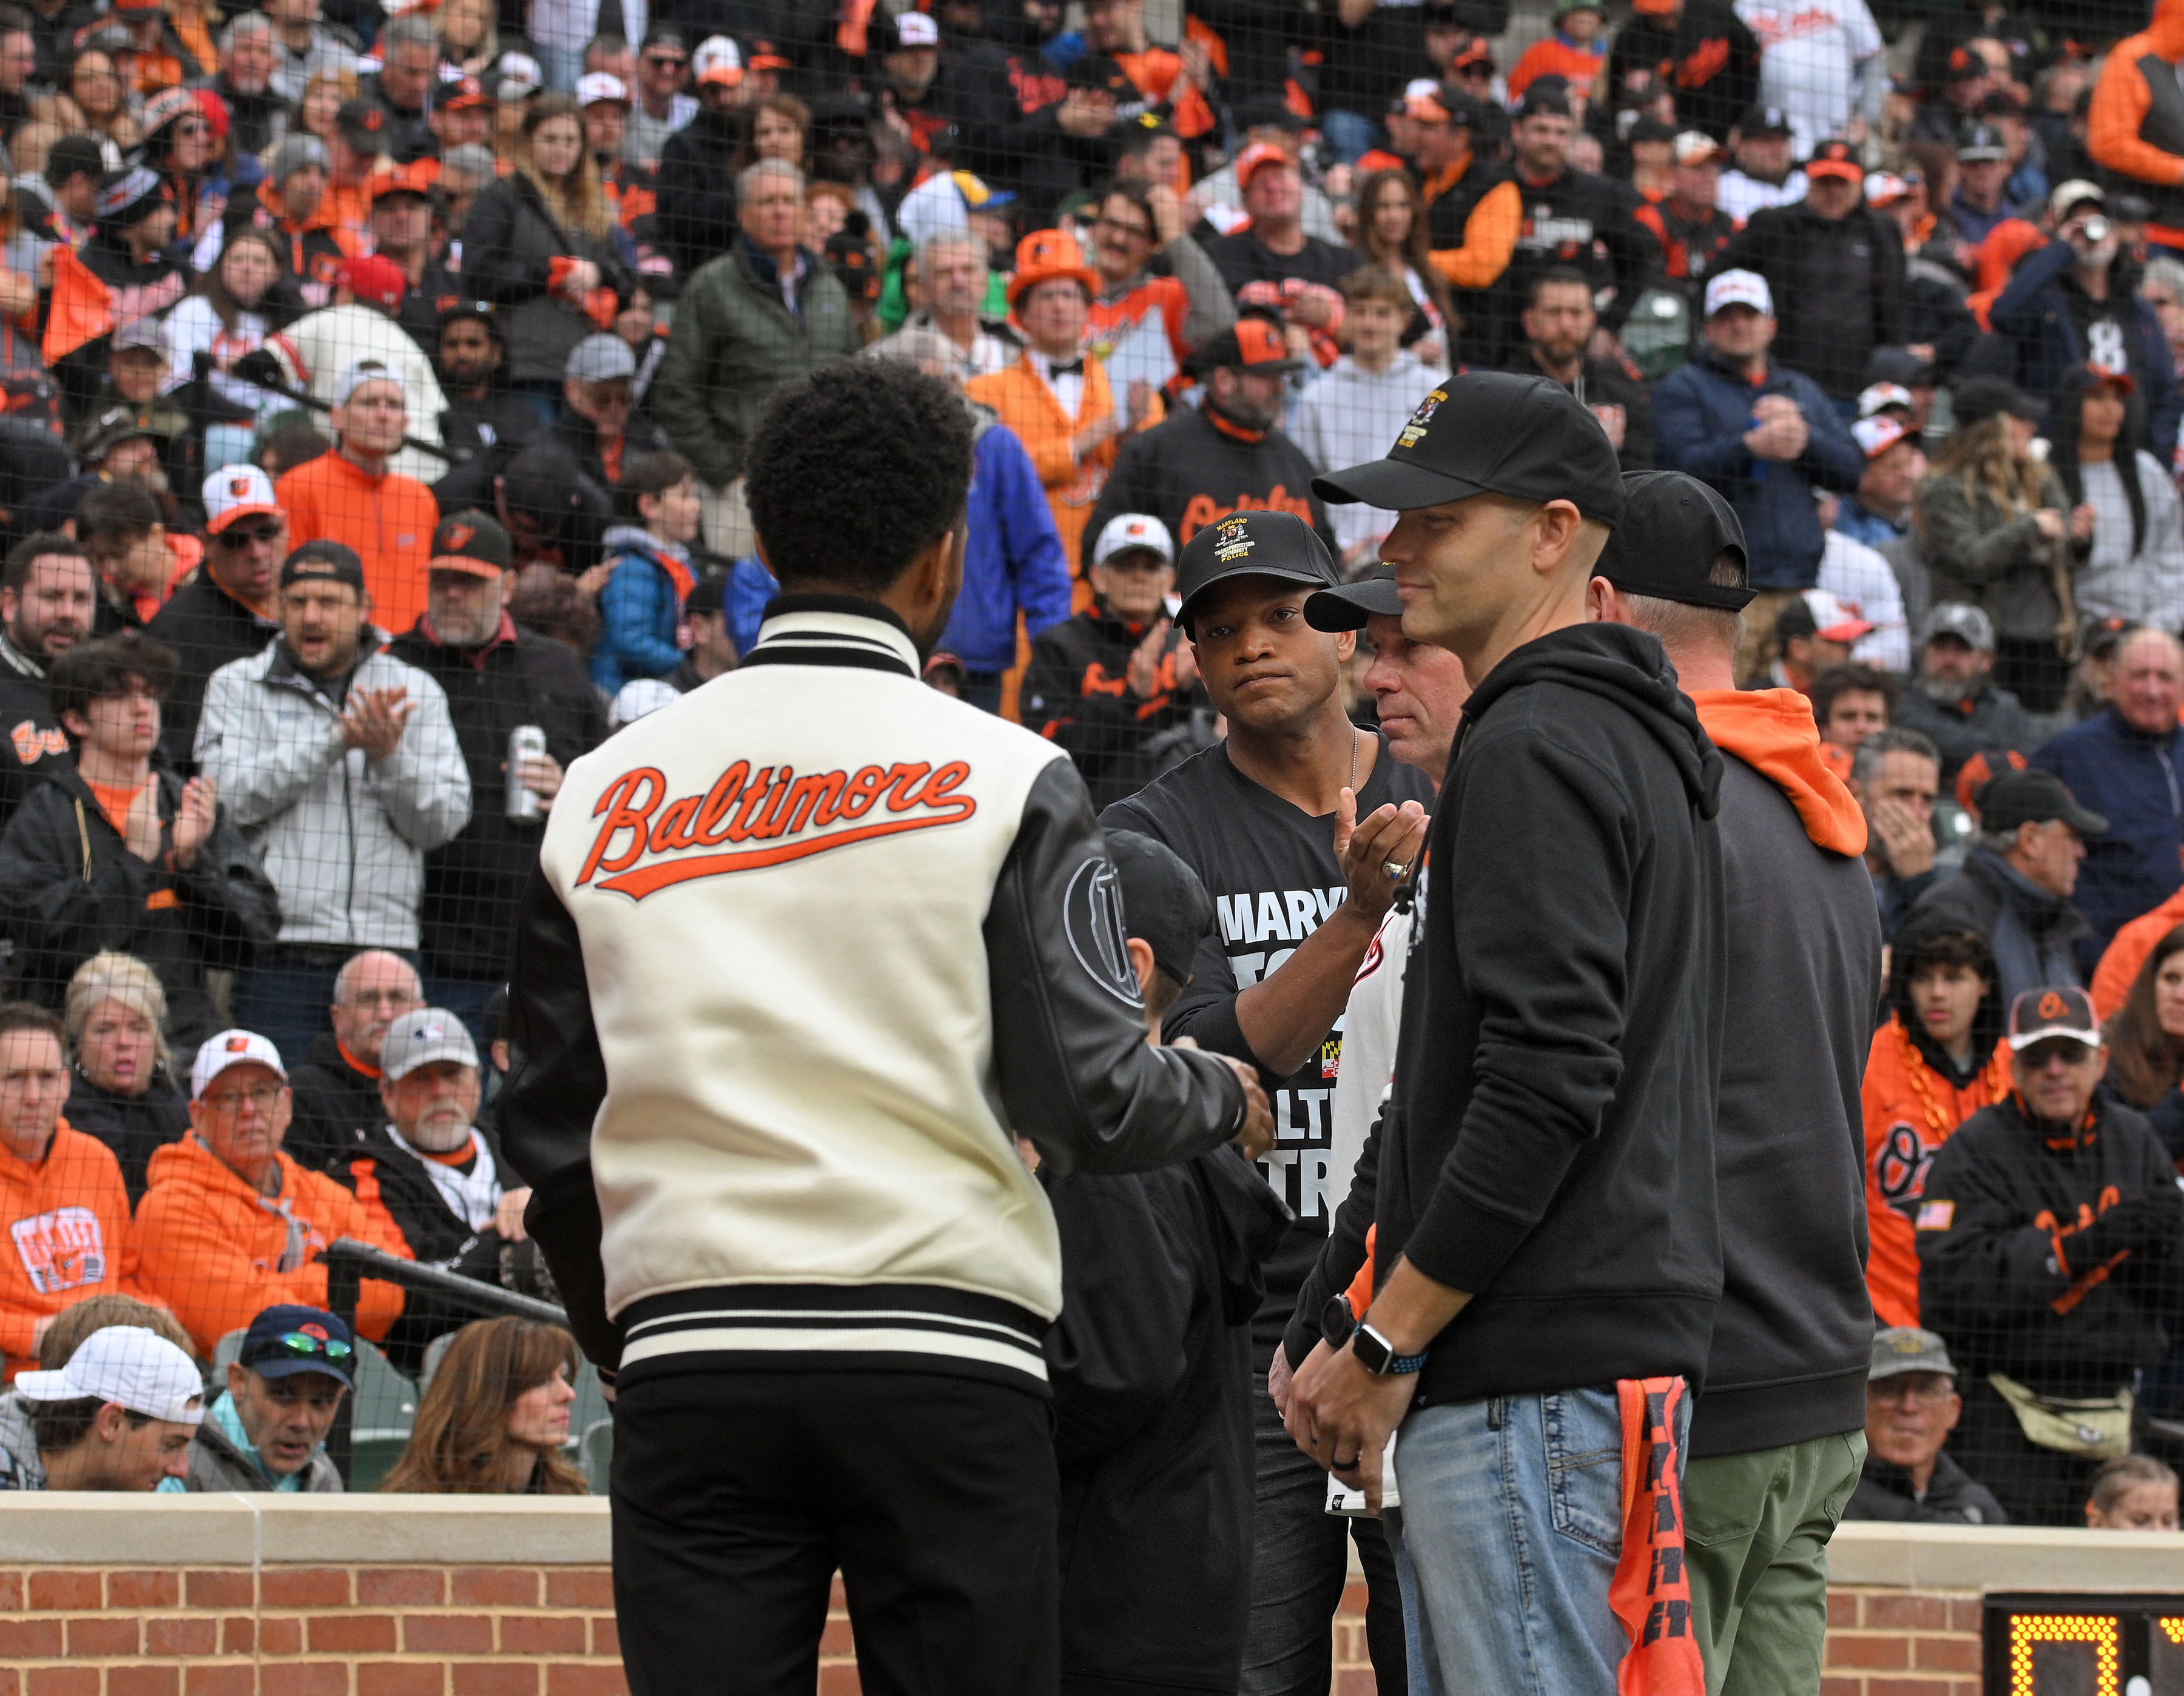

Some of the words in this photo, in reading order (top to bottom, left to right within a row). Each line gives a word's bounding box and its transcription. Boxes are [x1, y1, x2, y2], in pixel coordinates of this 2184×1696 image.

[1216, 518, 1247, 531] MARYLAND
[1214, 541, 1255, 556] TRANSPORTATION
[1221, 547, 1248, 559] AUTHORITY
[1221, 551, 1249, 563] POLICE
[575, 759, 977, 889] Baltimore
[1216, 886, 1347, 946] MARY
